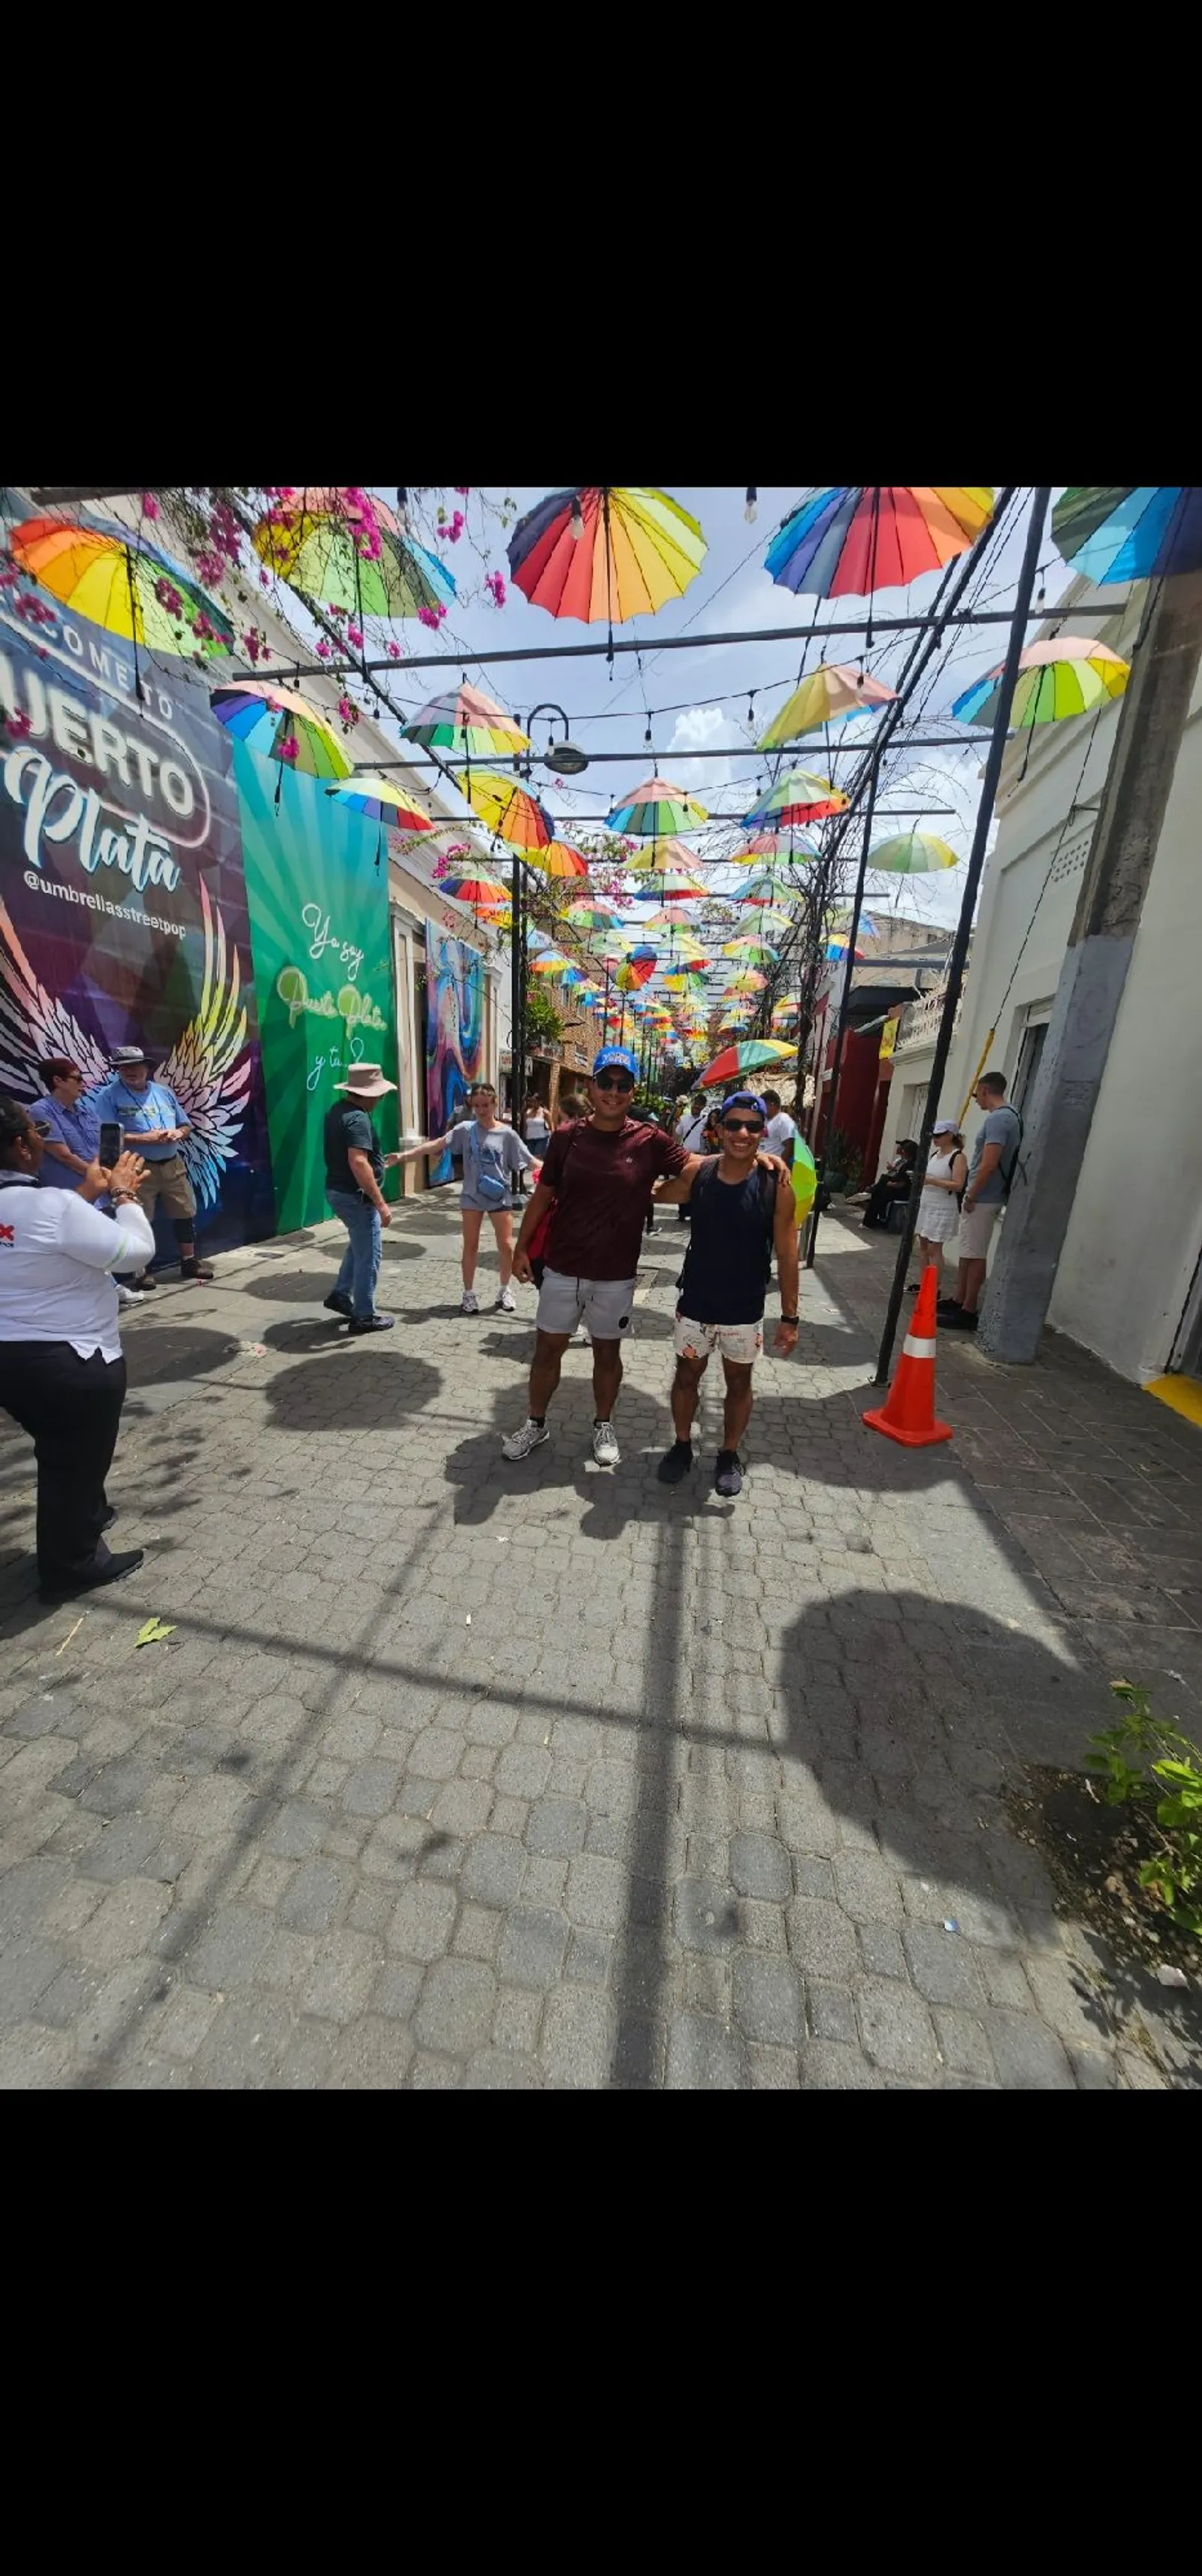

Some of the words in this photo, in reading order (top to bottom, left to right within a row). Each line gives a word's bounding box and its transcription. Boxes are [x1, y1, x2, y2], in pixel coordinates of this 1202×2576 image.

[138, 680, 173, 719] TO
[4, 745, 181, 891] Plata
[307, 1055, 325, 1090] y
